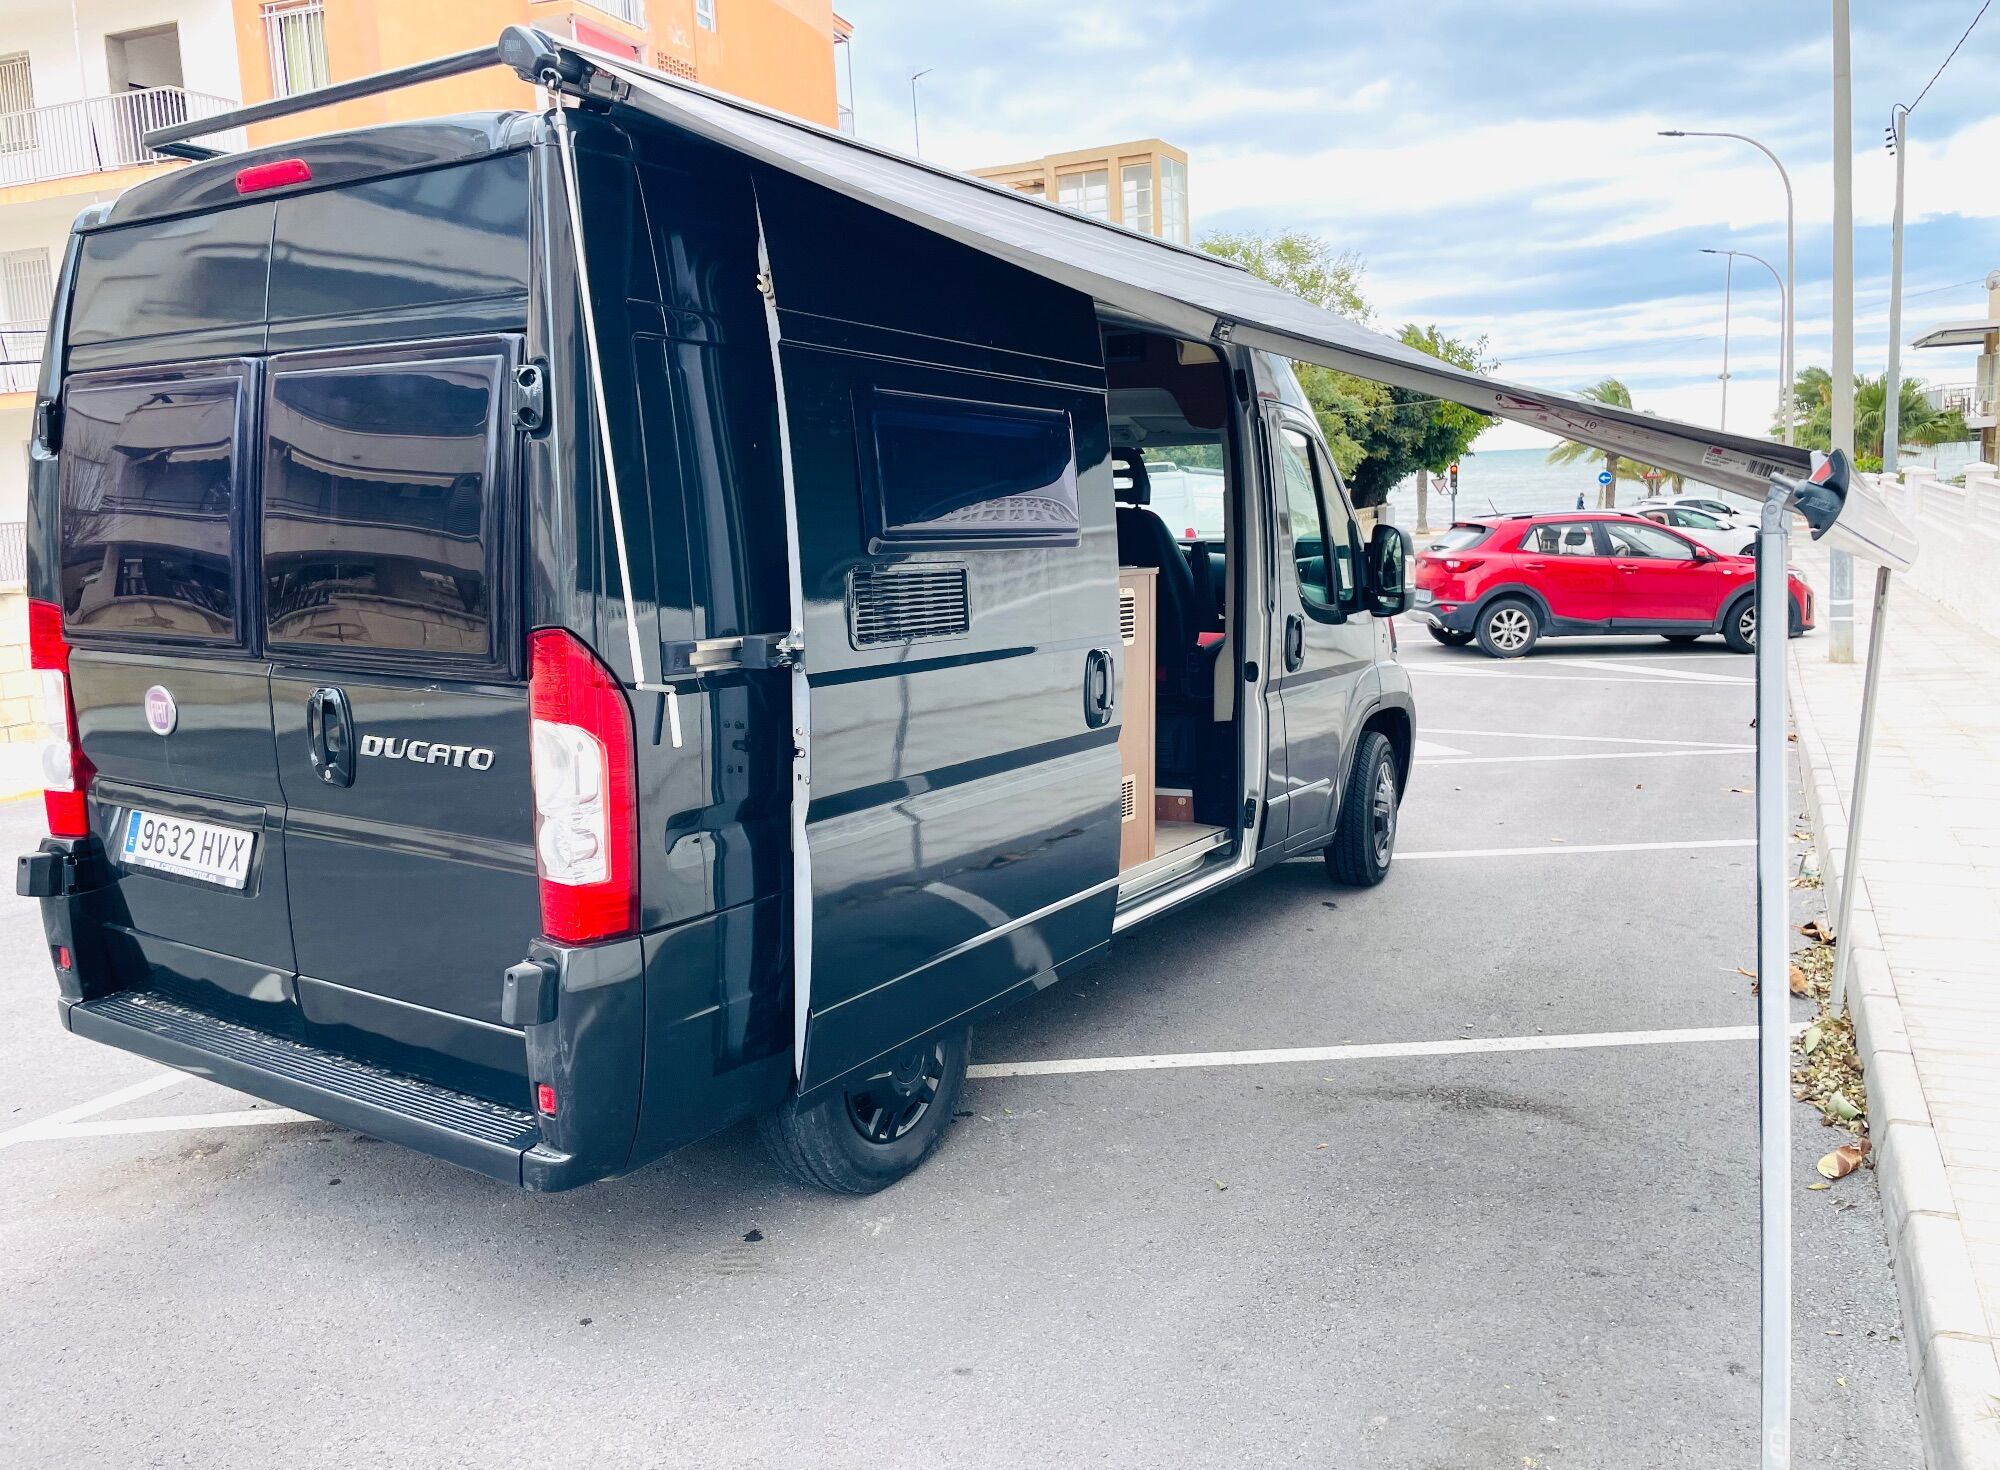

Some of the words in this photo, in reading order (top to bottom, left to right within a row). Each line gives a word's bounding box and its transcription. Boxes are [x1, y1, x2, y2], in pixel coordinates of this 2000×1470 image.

[151, 701, 168, 723] FIAT
[360, 735, 495, 771] DUCATO
[142, 819, 196, 861] 9632
[199, 830, 245, 872] HVX
